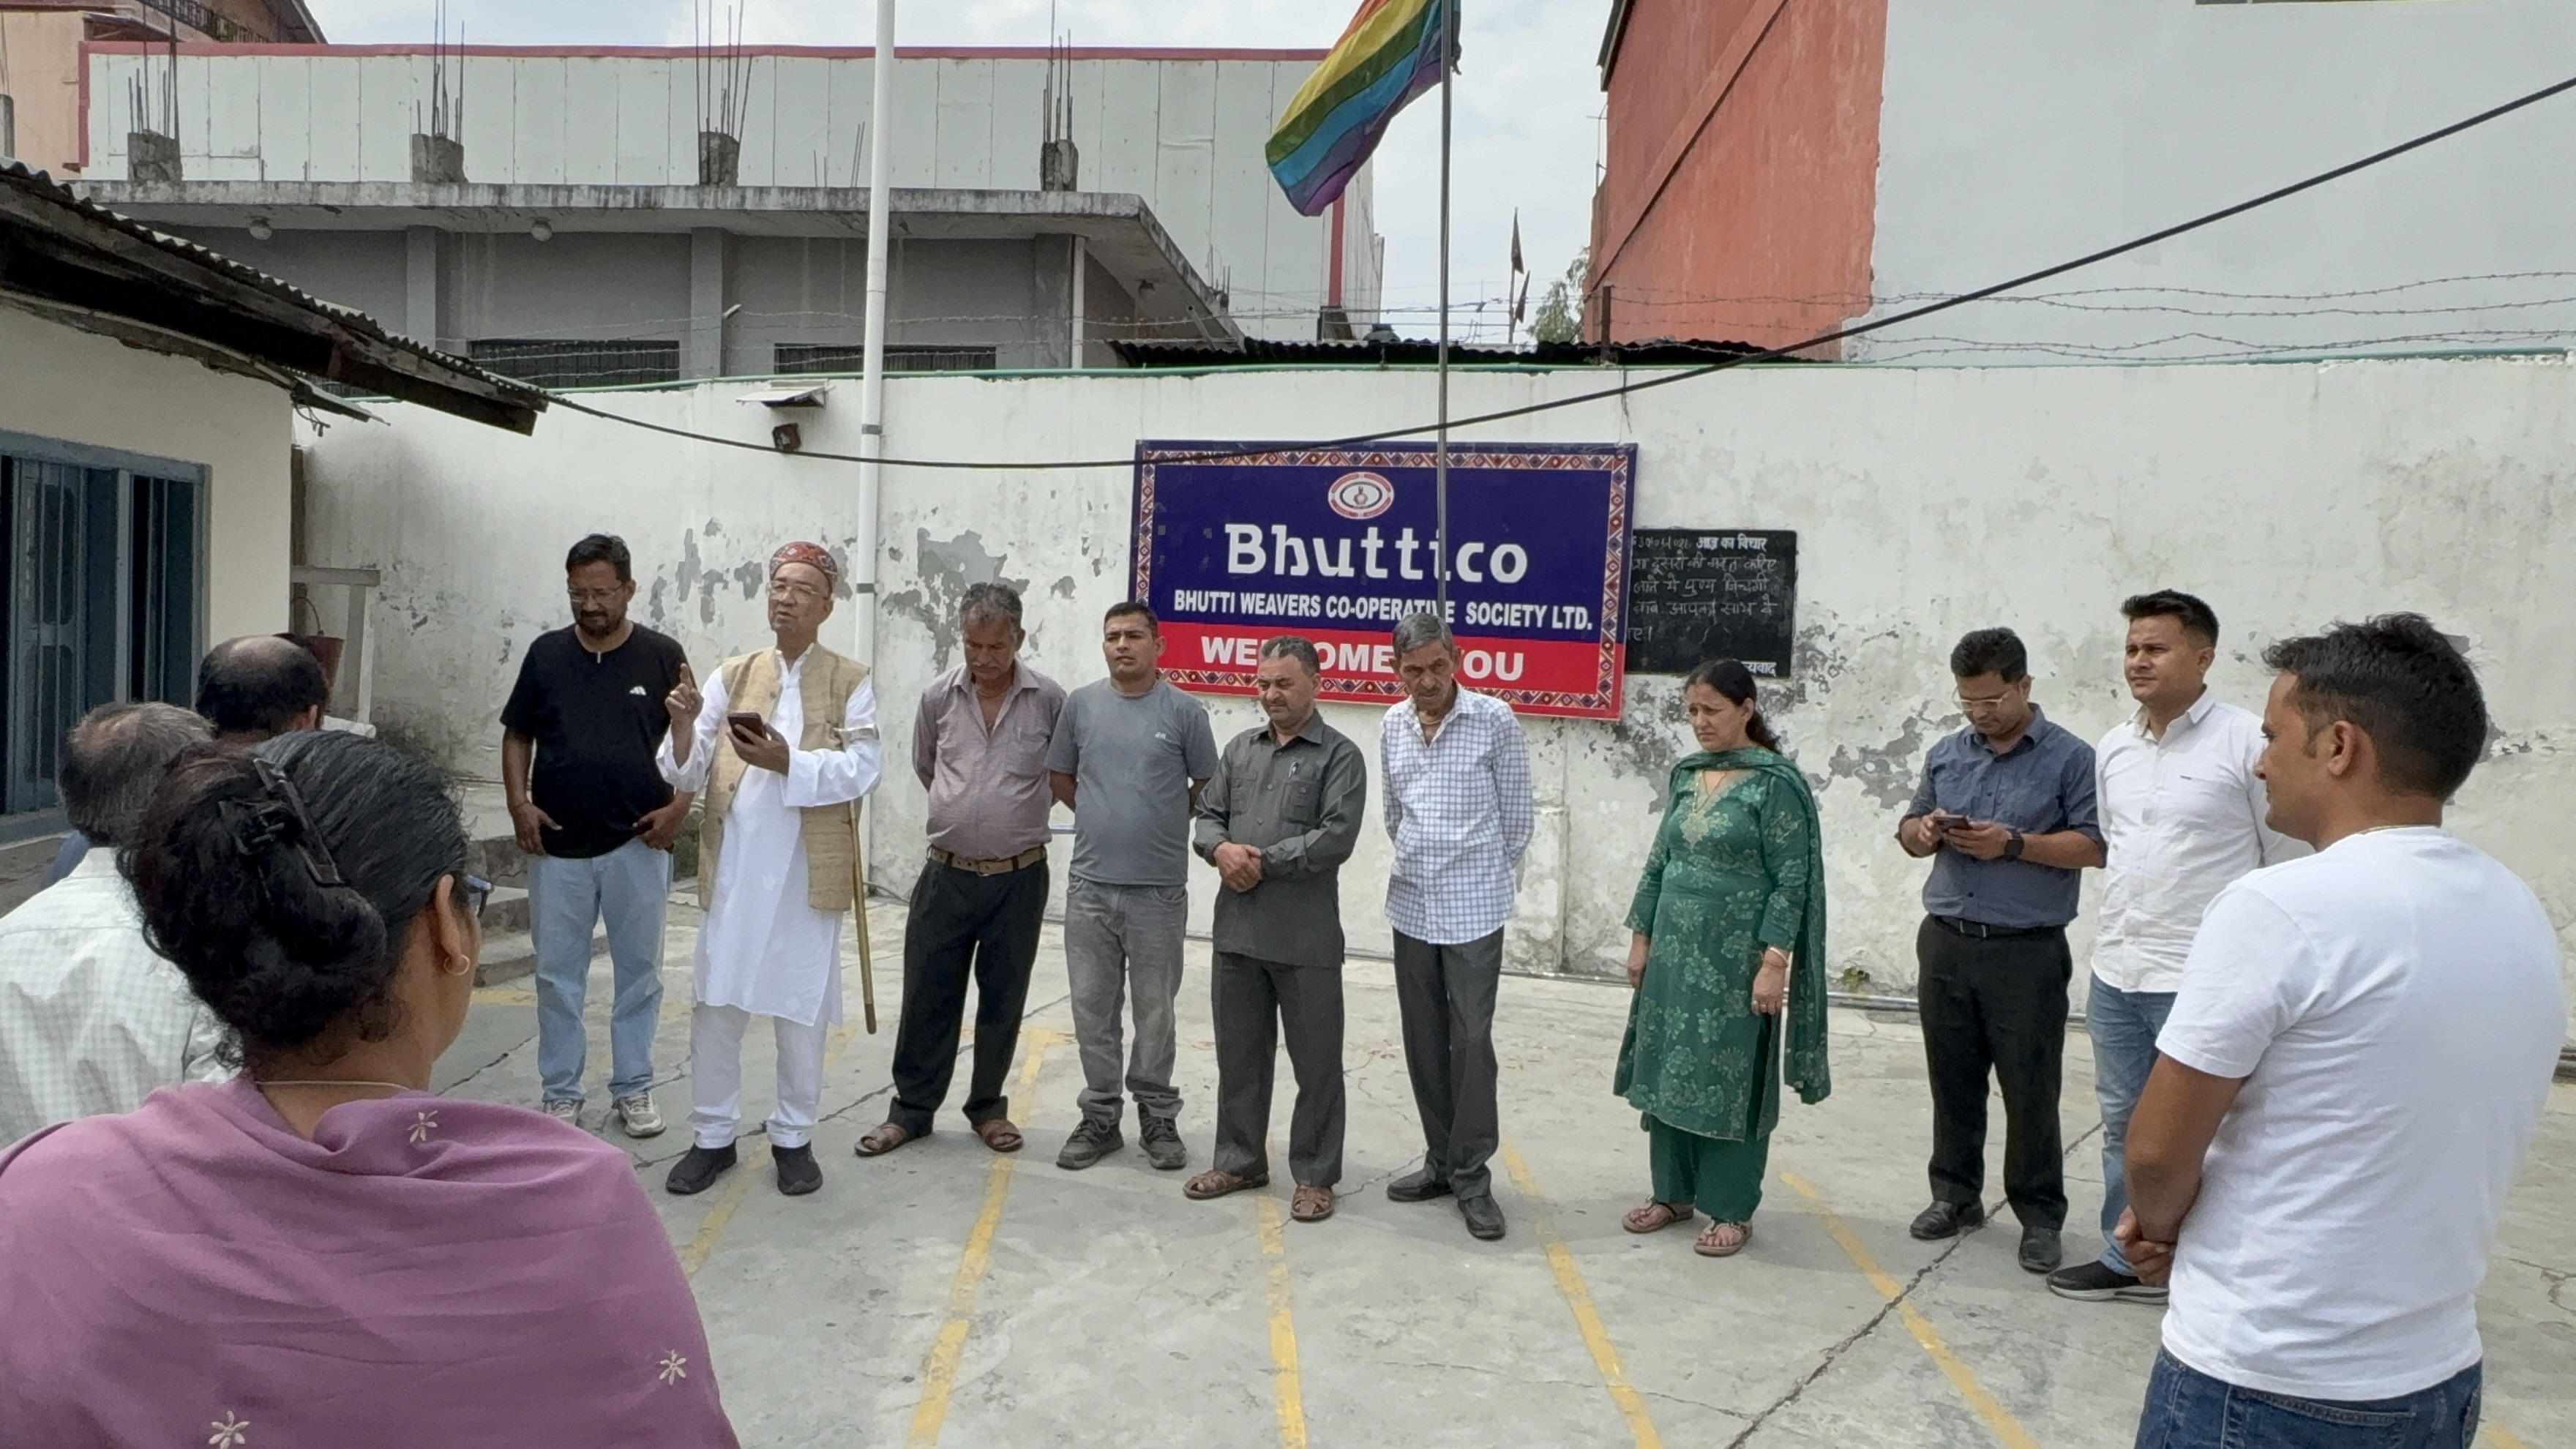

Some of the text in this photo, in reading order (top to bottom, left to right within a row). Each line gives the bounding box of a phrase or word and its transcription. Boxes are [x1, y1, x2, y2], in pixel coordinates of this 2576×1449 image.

[1696, 536, 1718, 550] आज
[1721, 537, 1734, 550] का
[1737, 533, 1767, 553] विचार
[1174, 589, 1235, 613] BHUTTI
[1240, 592, 1320, 618] WEAVERS
[1465, 602, 1547, 629] SOCIETY
[1551, 605, 1592, 630] LTD.
[1201, 636, 1524, 681] WEOME OU
